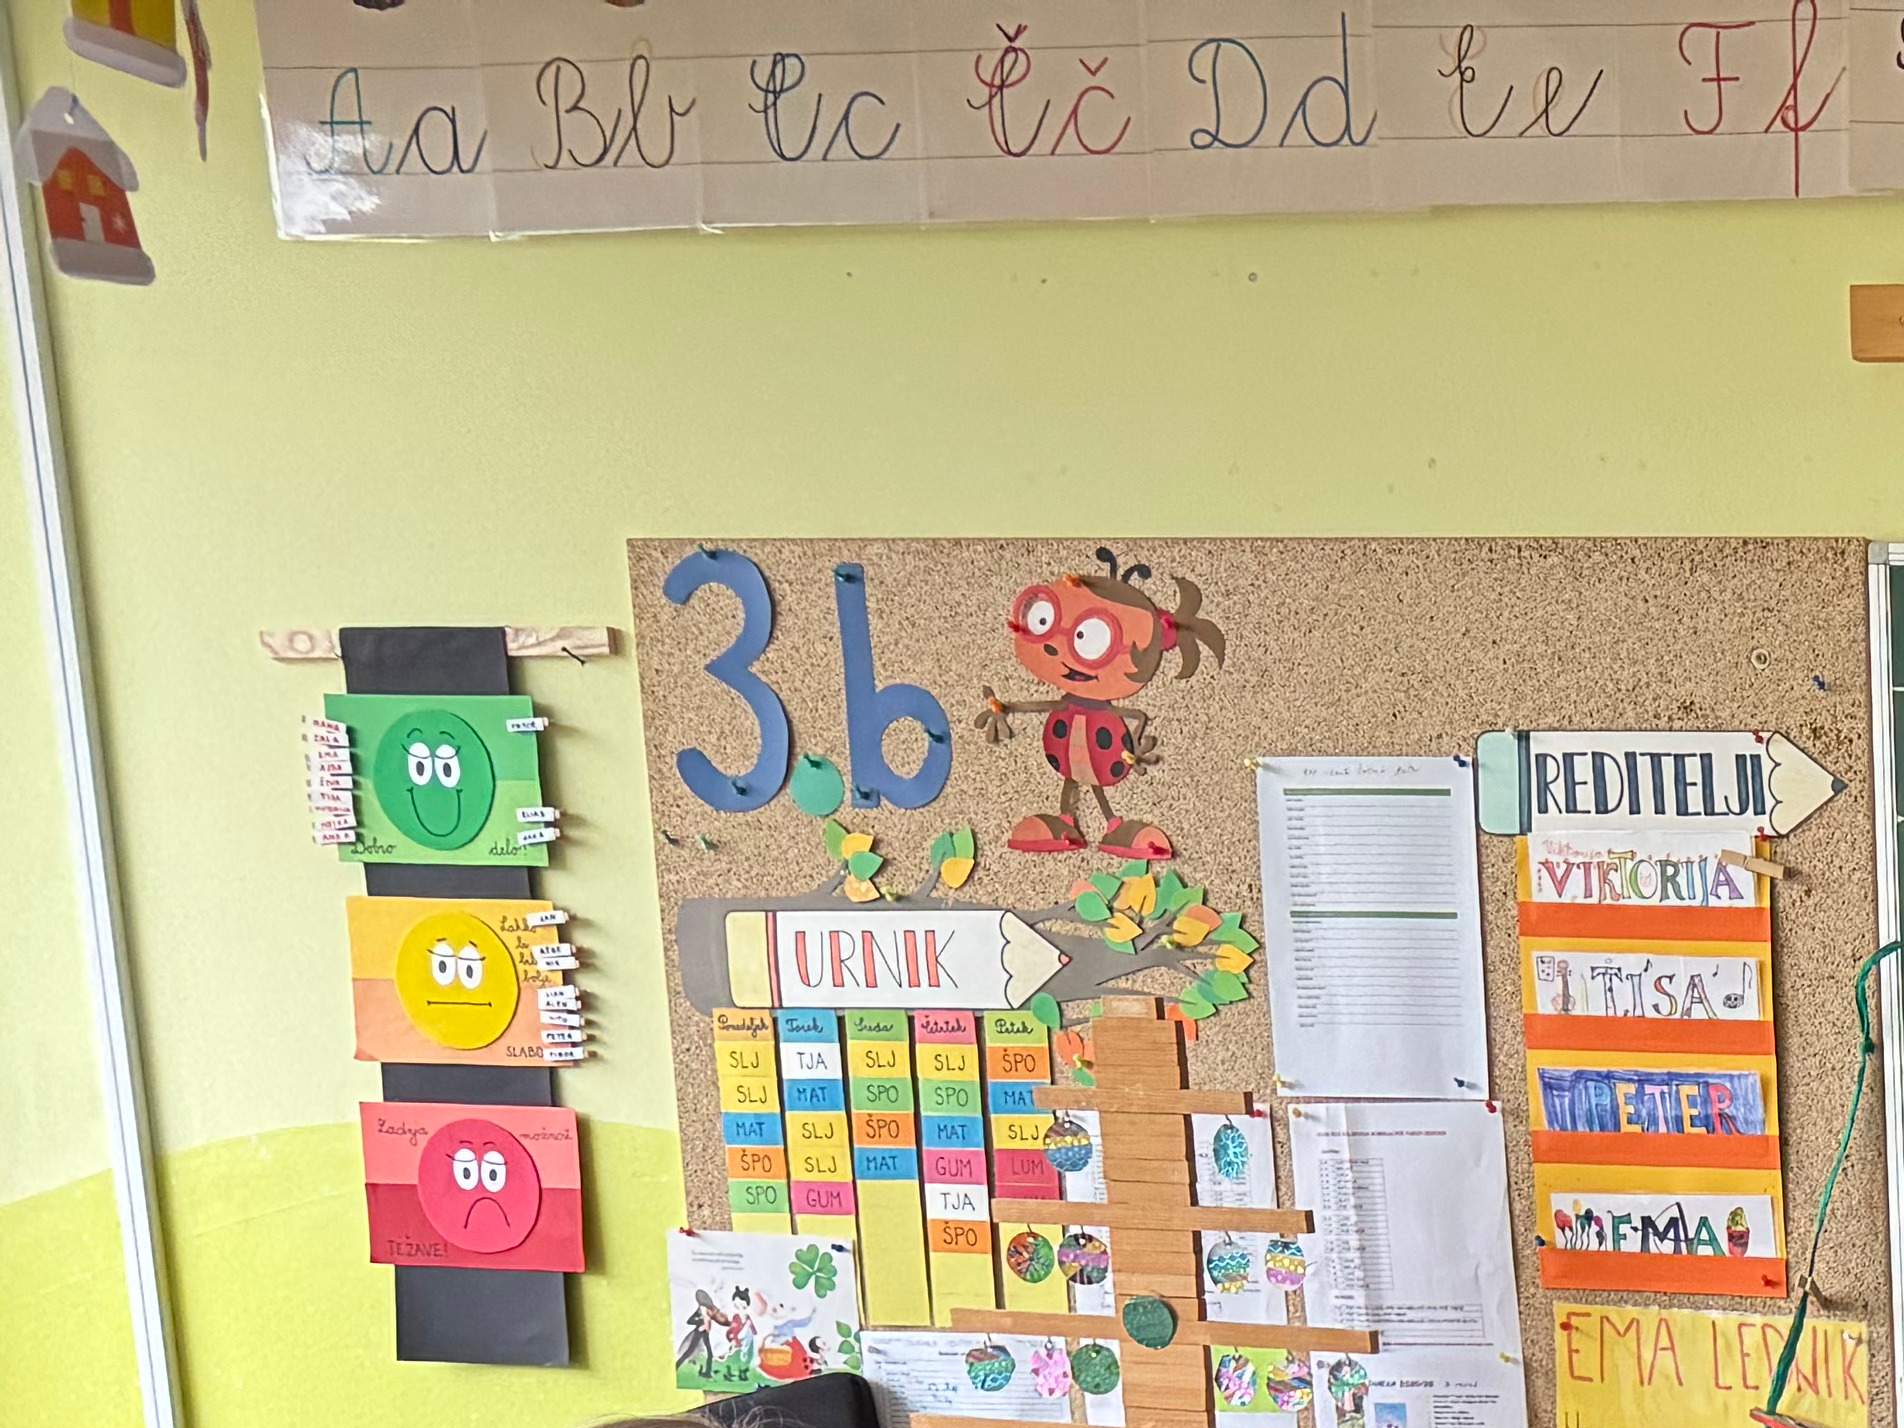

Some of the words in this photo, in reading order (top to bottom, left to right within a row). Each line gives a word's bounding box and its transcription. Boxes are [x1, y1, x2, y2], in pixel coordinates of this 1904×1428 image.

[1187, 11, 1379, 151] Dd
[1535, 751, 1767, 817] REDITELJI
[1540, 850, 1746, 906] VIKTORIJA
[794, 930, 959, 991] URNIK
[729, 1050, 760, 1069] SLJ
[797, 1051, 828, 1070] TJA
[865, 1050, 897, 1069] SLJ
[934, 1053, 966, 1072] SLJ
[1002, 1049, 1036, 1073] ŠPO
[736, 1084, 768, 1104] SLJ
[796, 1086, 827, 1104] MAT
[866, 1084, 899, 1103] SPO
[934, 1087, 969, 1107] SPO
[1586, 1081, 1748, 1135] PETER
[735, 1121, 765, 1138] MAT
[801, 1122, 834, 1140] SLJ
[865, 1113, 900, 1139] ŠPO
[936, 1123, 968, 1140] MAT
[1008, 1123, 1039, 1141] SLJ
[740, 1149, 772, 1173] ŠPO
[804, 1154, 837, 1174] SLJ
[865, 1155, 898, 1172] MAT
[935, 1156, 973, 1178] GUM
[1011, 1156, 1045, 1175] LUM
[745, 1186, 777, 1205] SPO
[805, 1189, 843, 1209] GUM
[943, 1191, 977, 1212] TJA
[943, 1223, 978, 1248] ŠPO
[1566, 1312, 1684, 1387] EMA
